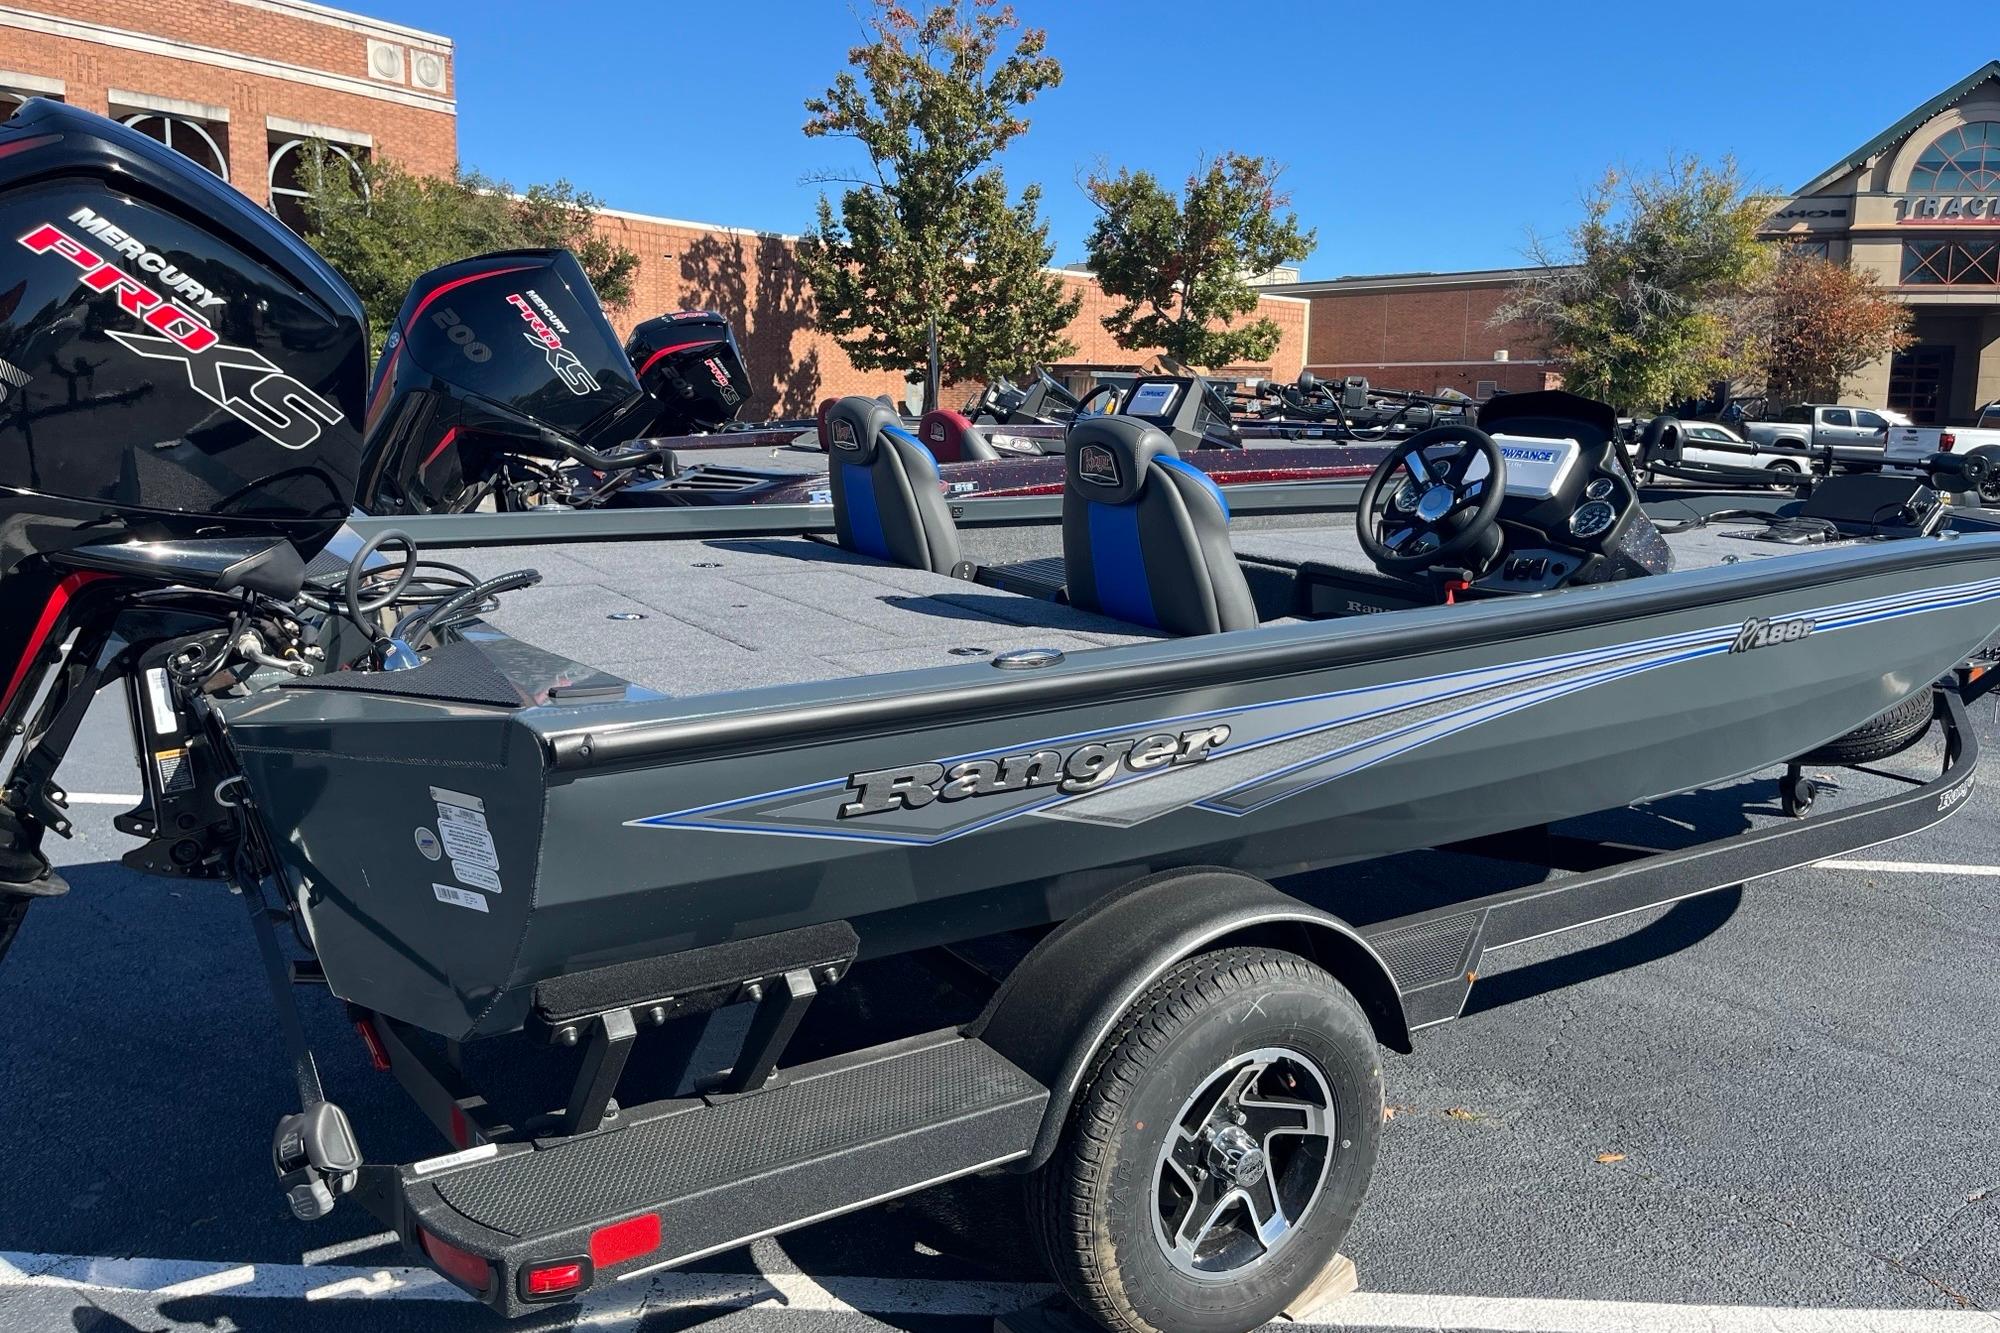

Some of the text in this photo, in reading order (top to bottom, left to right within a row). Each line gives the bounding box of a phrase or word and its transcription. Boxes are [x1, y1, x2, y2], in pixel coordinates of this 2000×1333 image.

[17, 223, 219, 353] PRO
[67, 206, 227, 309] MERCURY
[431, 307, 493, 363] 200
[505, 293, 562, 349] PRO
[525, 289, 570, 334] MERCURY
[103, 296, 345, 449] XS
[523, 326, 601, 395] XS
[1500, 447, 1553, 462] OWRANCE
[1346, 600, 1392, 614] Ran
[836, 723, 1232, 820] Ranger
[1109, 1157, 1135, 1249] STAR
